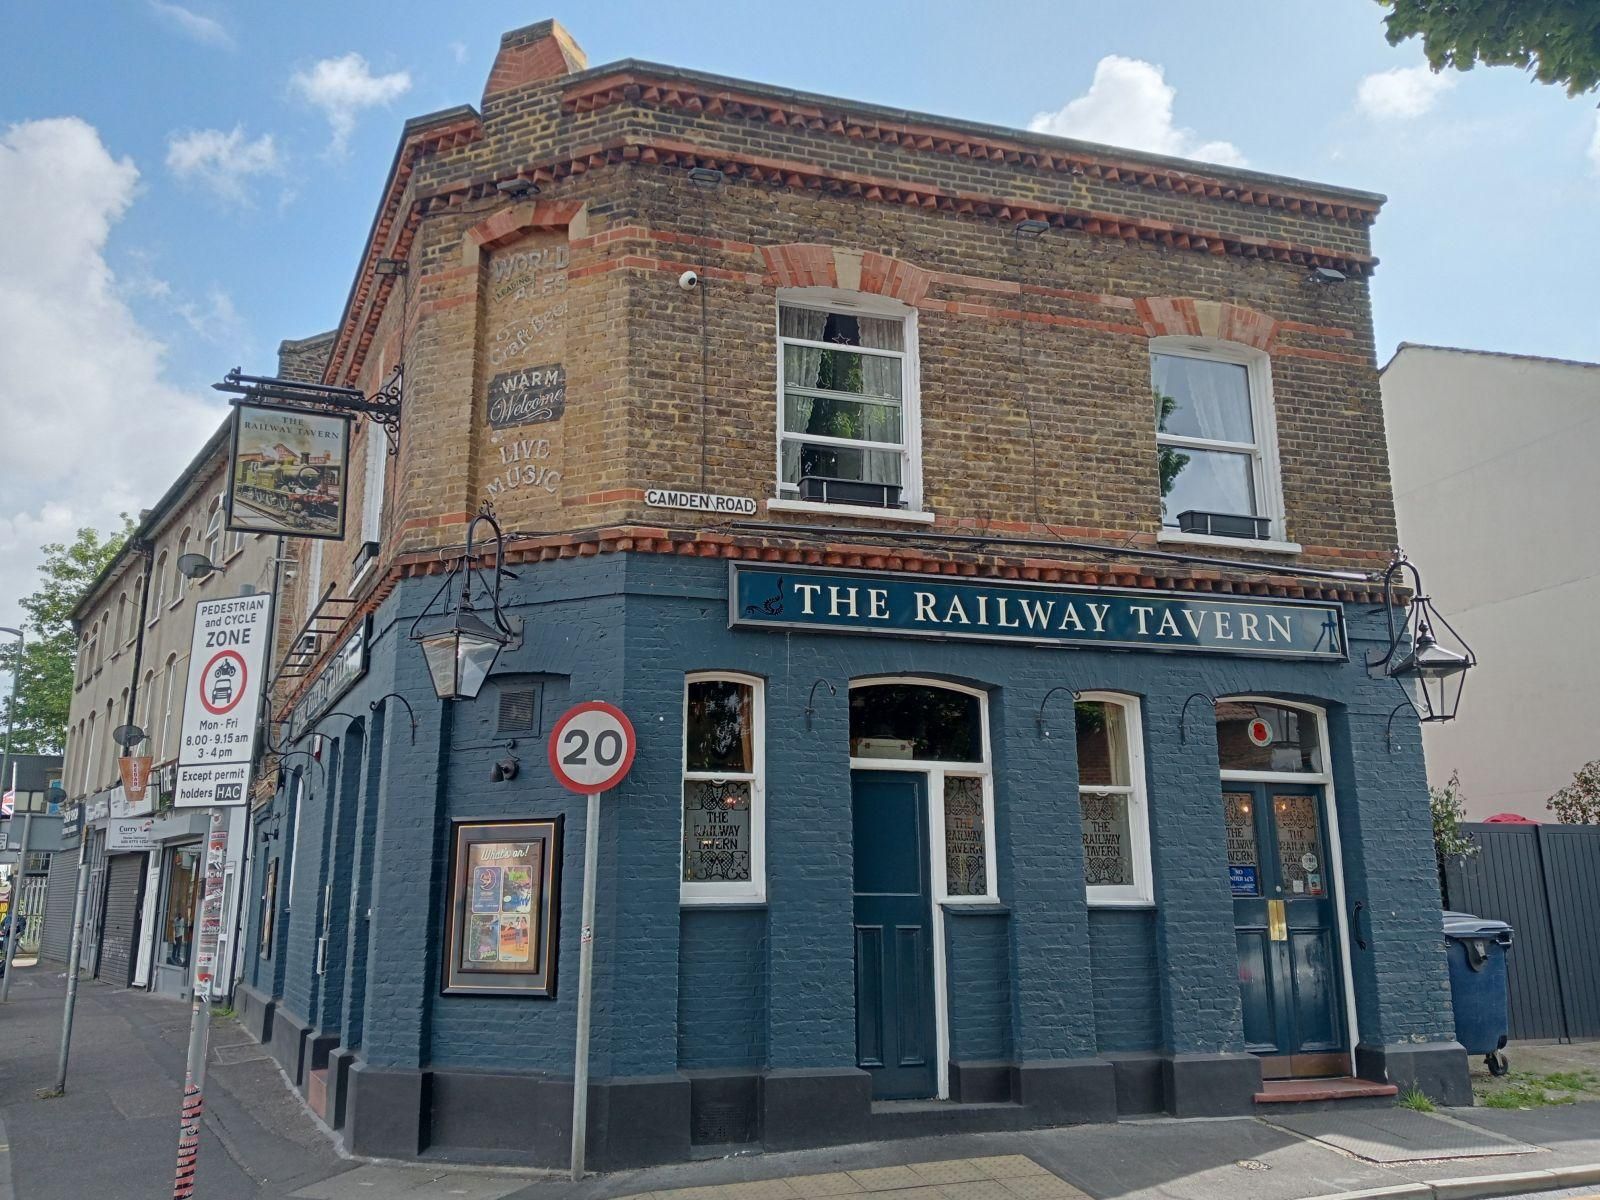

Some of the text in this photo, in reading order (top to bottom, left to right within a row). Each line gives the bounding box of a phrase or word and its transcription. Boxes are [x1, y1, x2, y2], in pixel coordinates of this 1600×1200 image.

[496, 275, 533, 298] LEADING
[502, 371, 559, 393] WARM
[490, 389, 563, 423] Welcome
[282, 417, 304, 426] THE
[244, 421, 340, 439] RAILWAY TAVERN
[499, 440, 550, 465] LIVE
[486, 465, 560, 500] MUSIC
[648, 491, 754, 512] CAMDEN ROAD
[202, 600, 264, 616] PEDESTRIAN
[794, 584, 1291, 643] THE RAILWAY TAVERN
[205, 613, 256, 627] and CYCLE
[206, 628, 251, 647] ZONE
[200, 720, 218, 730] Mon
[226, 718, 238, 728] Fri
[186, 734, 208, 746] 8.00
[214, 733, 233, 744] 9.15
[235, 734, 248, 743] am
[198, 748, 204, 758] 3
[210, 747, 217, 757] 4
[218, 748, 232, 759] pm
[563, 729, 622, 767] 20
[182, 768, 244, 782] Except permit
[180, 785, 241, 799] holders HAC
[707, 812, 729, 823] THE
[954, 817, 974, 829] THE
[119, 825, 138, 833] Curry
[694, 825, 740, 836] RAILWAY
[1091, 821, 1110, 832] THE
[1226, 827, 1243, 838] THE
[1082, 833, 1120, 844] RAILWAY
[1287, 829, 1306, 840] THE
[697, 838, 738, 849] TAVERN
[480, 845, 530, 861] What's on!
[1085, 846, 1120, 856] TAVERN
